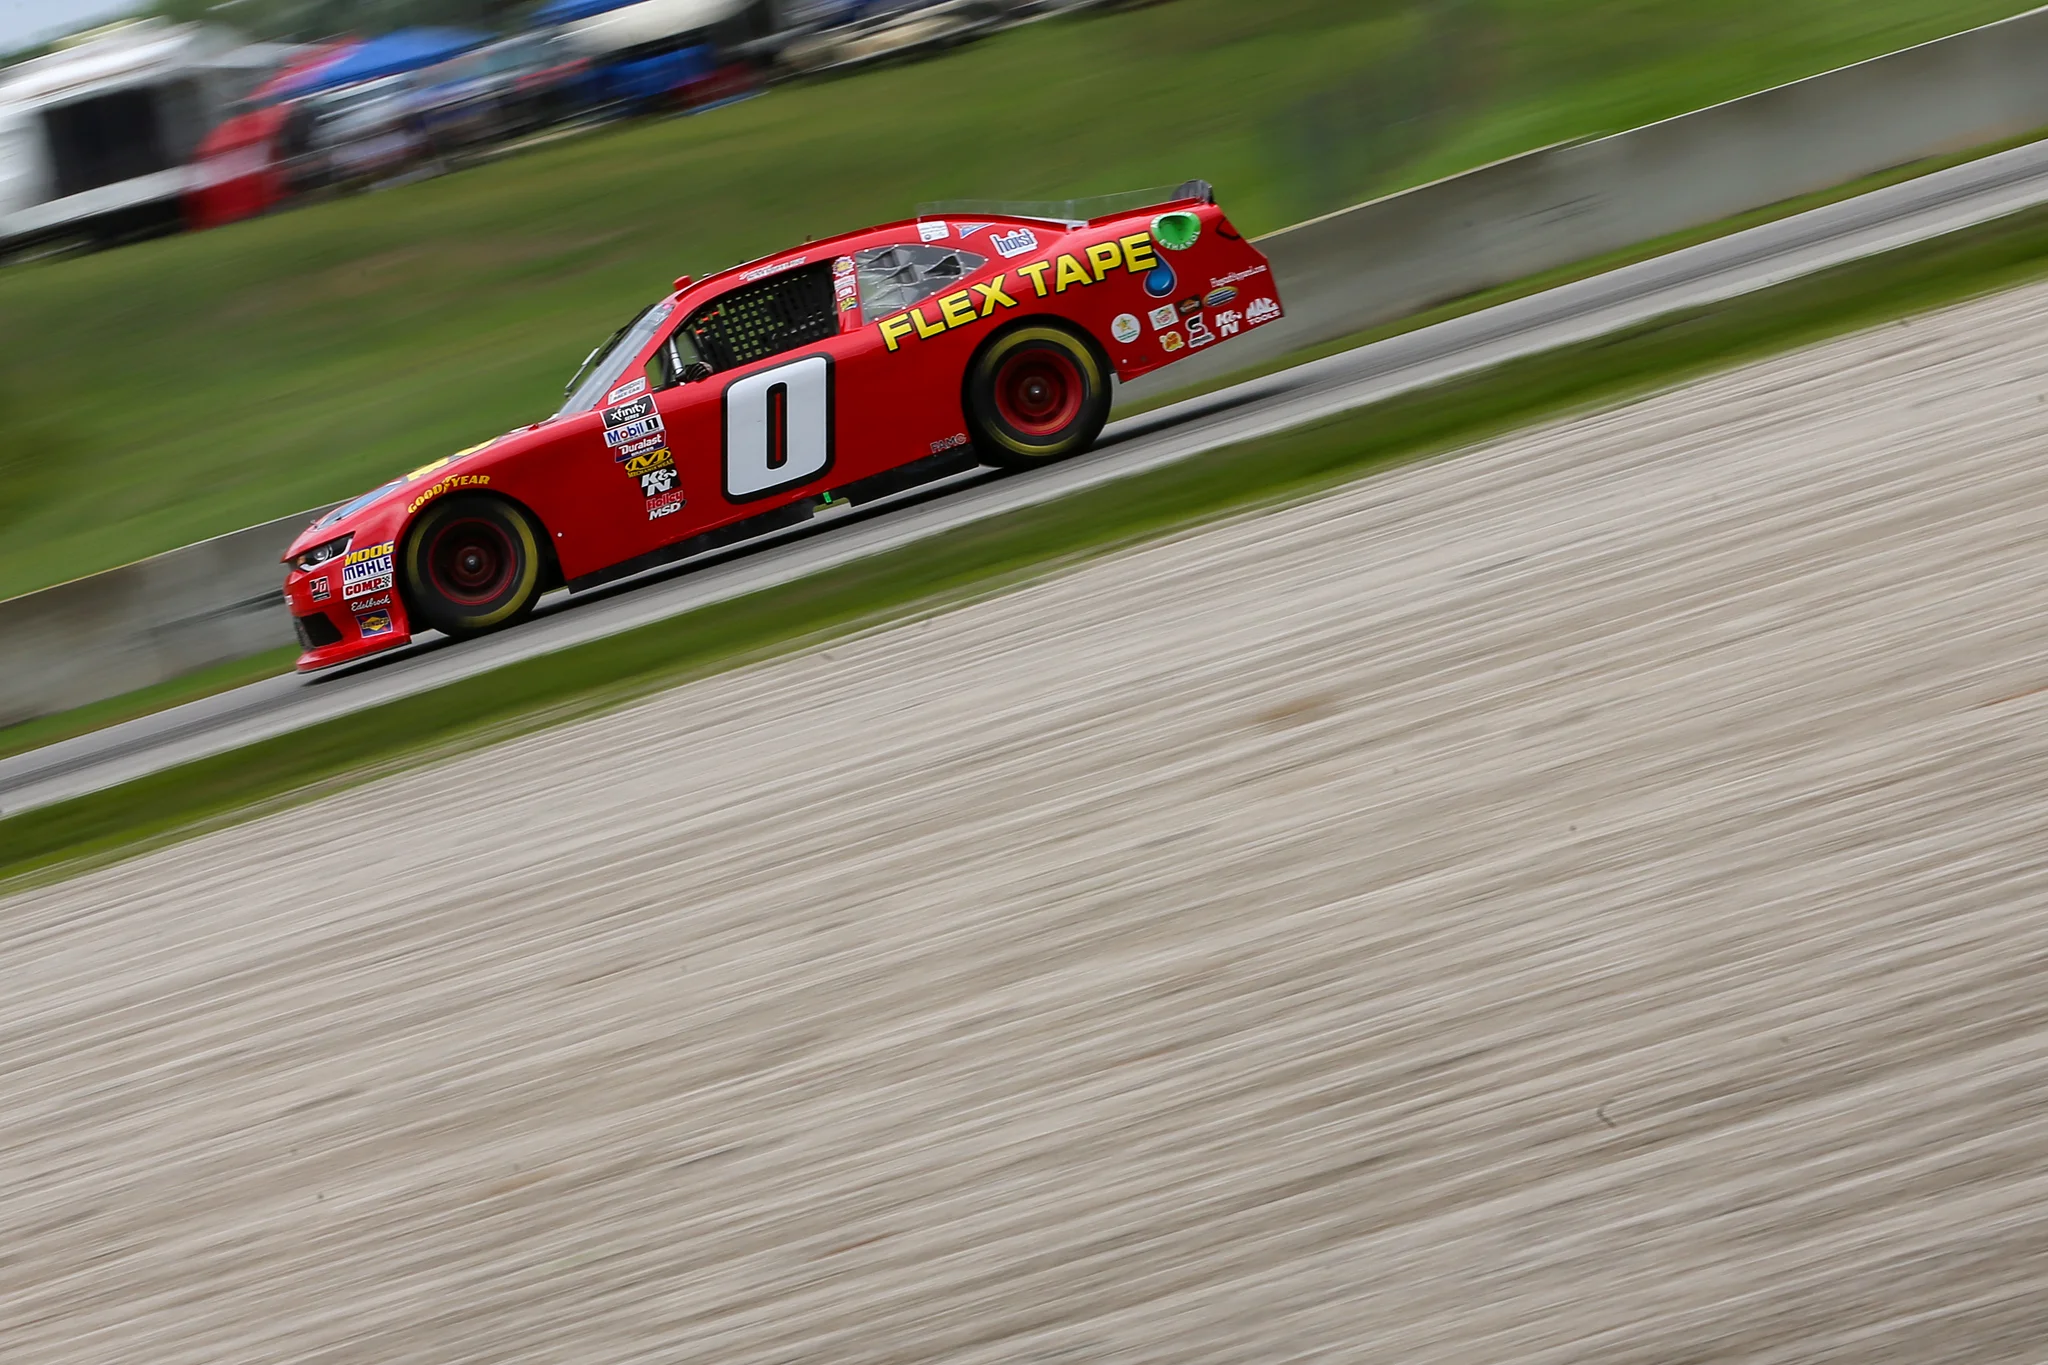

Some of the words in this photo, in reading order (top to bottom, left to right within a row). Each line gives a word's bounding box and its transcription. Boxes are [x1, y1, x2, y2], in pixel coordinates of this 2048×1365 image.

[993, 229, 1034, 253] hoist
[1159, 231, 1200, 251] ETHANOL
[878, 274, 1018, 352] FLEX
[1017, 231, 1158, 297] TAPE
[610, 403, 647, 421] xfinity
[607, 422, 644, 443] Mobil
[722, 352, 835, 503] 0
[618, 434, 662, 455] Duralast
[646, 490, 683, 512] Holley
[649, 502, 681, 520] MSD
[344, 541, 394, 567] MOOG
[344, 557, 392, 581] MAHLE
[345, 577, 382, 597] COMP
[351, 594, 391, 612] Edelbrock
